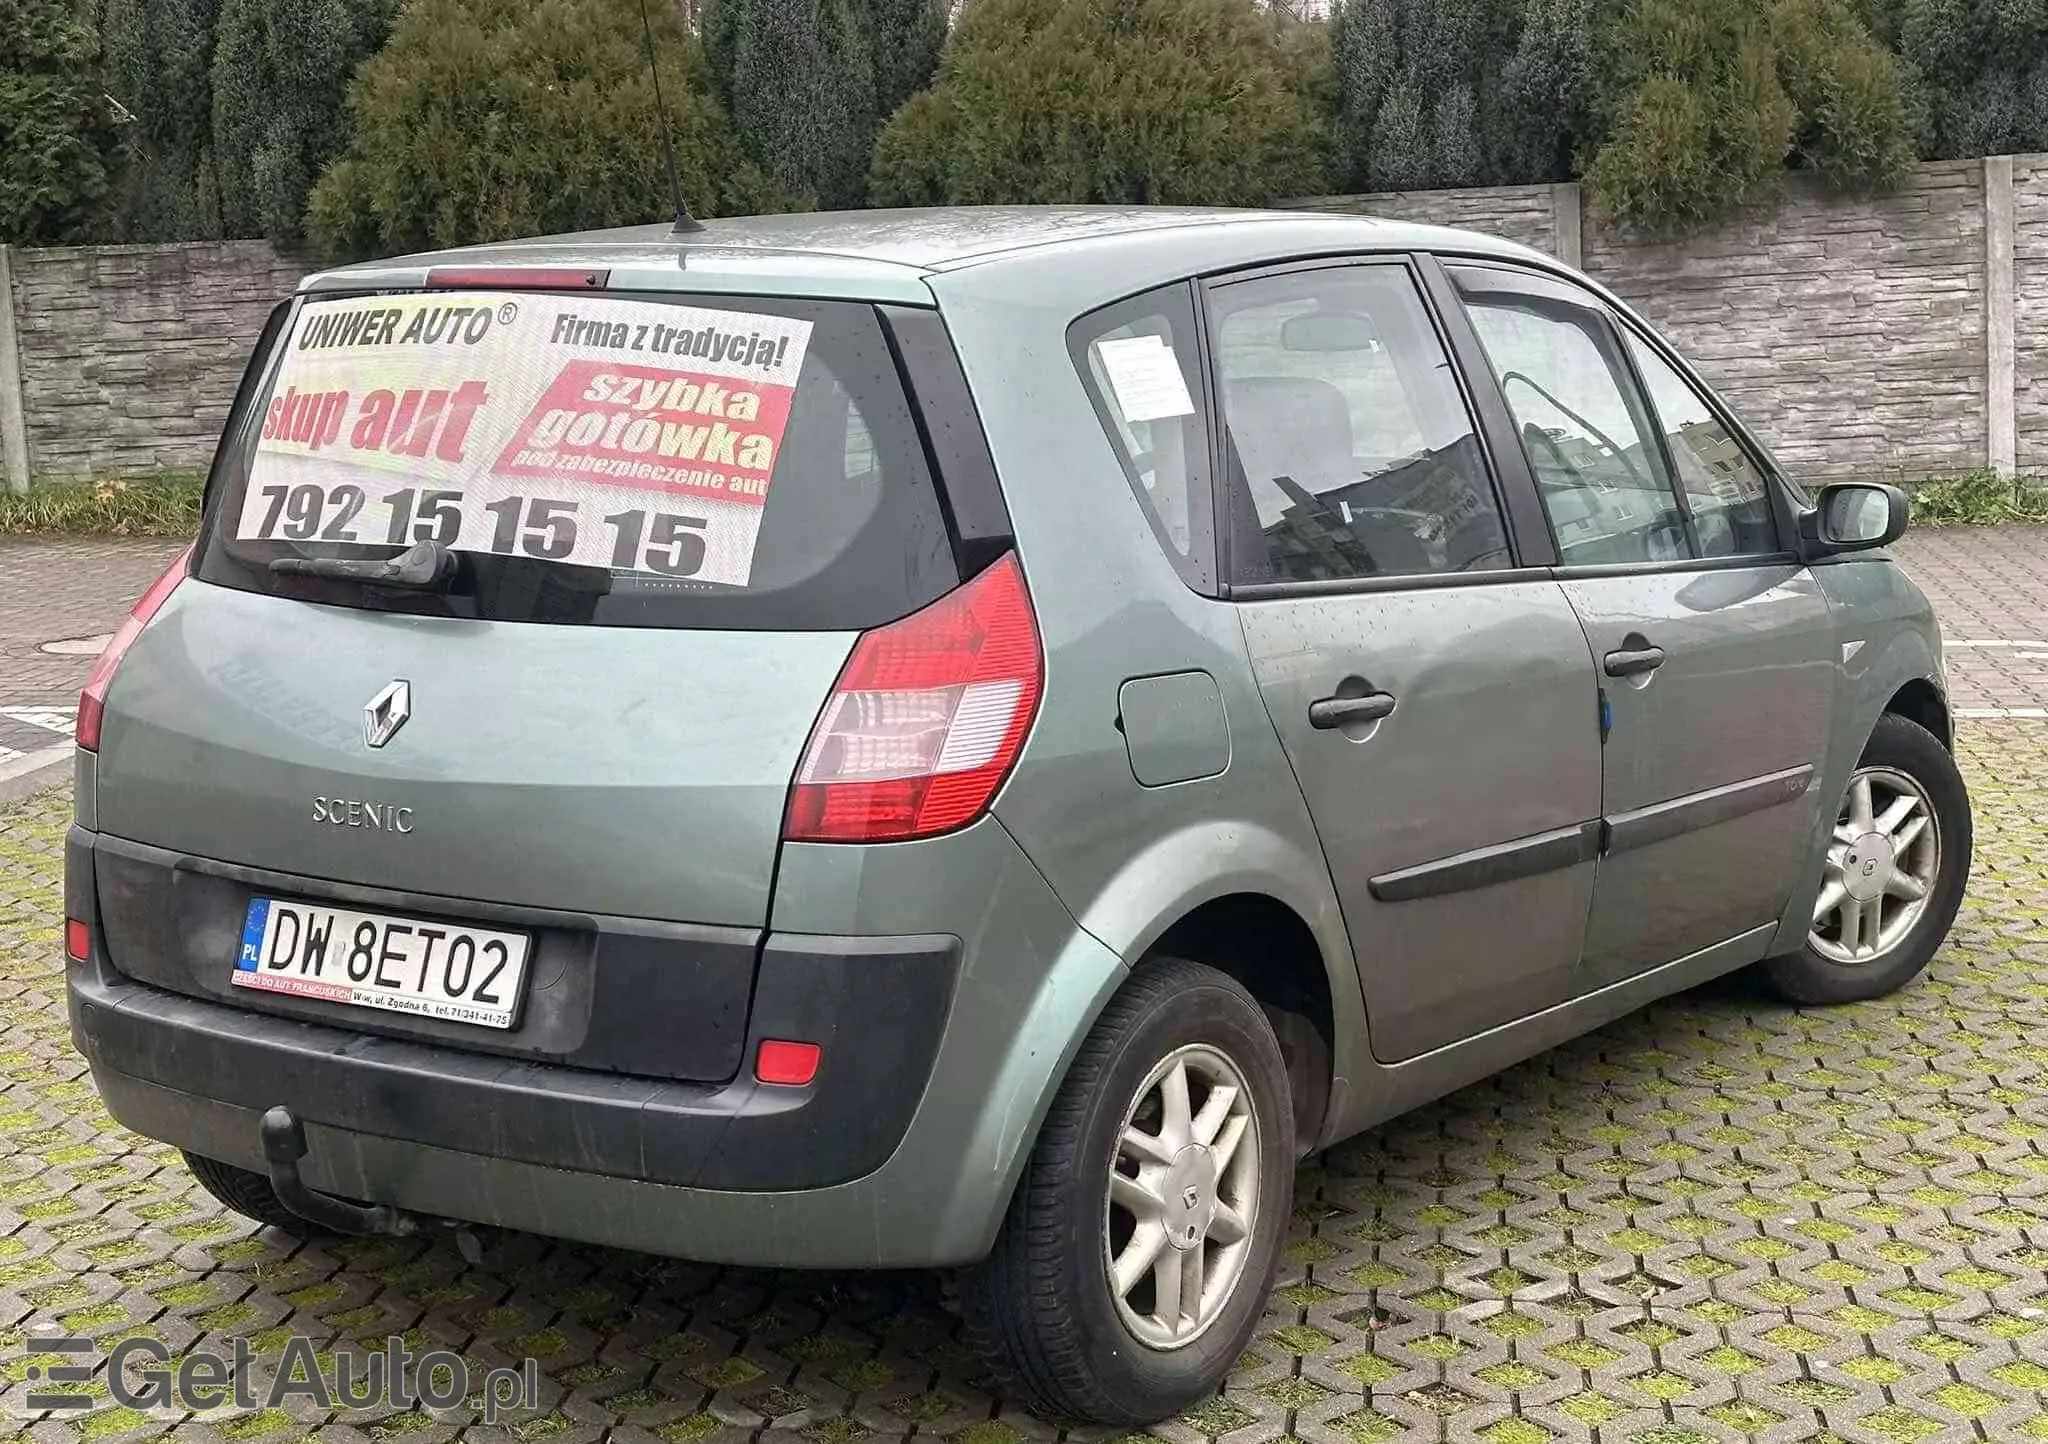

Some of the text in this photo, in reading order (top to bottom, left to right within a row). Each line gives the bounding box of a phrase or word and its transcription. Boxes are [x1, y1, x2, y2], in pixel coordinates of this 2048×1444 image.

[299, 309, 402, 350] UNIWER
[551, 313, 789, 371] Firma z tradycją!
[263, 381, 488, 463] skup aut
[583, 374, 761, 422] szybka
[527, 409, 775, 470] gotówka
[554, 451, 725, 490] zabezpieczenie
[728, 475, 767, 496] aut
[257, 484, 708, 577] 792 15 15 15
[311, 797, 415, 834] SCENIC
[241, 943, 258, 961] PL
[268, 909, 508, 1005] DW 8ET02
